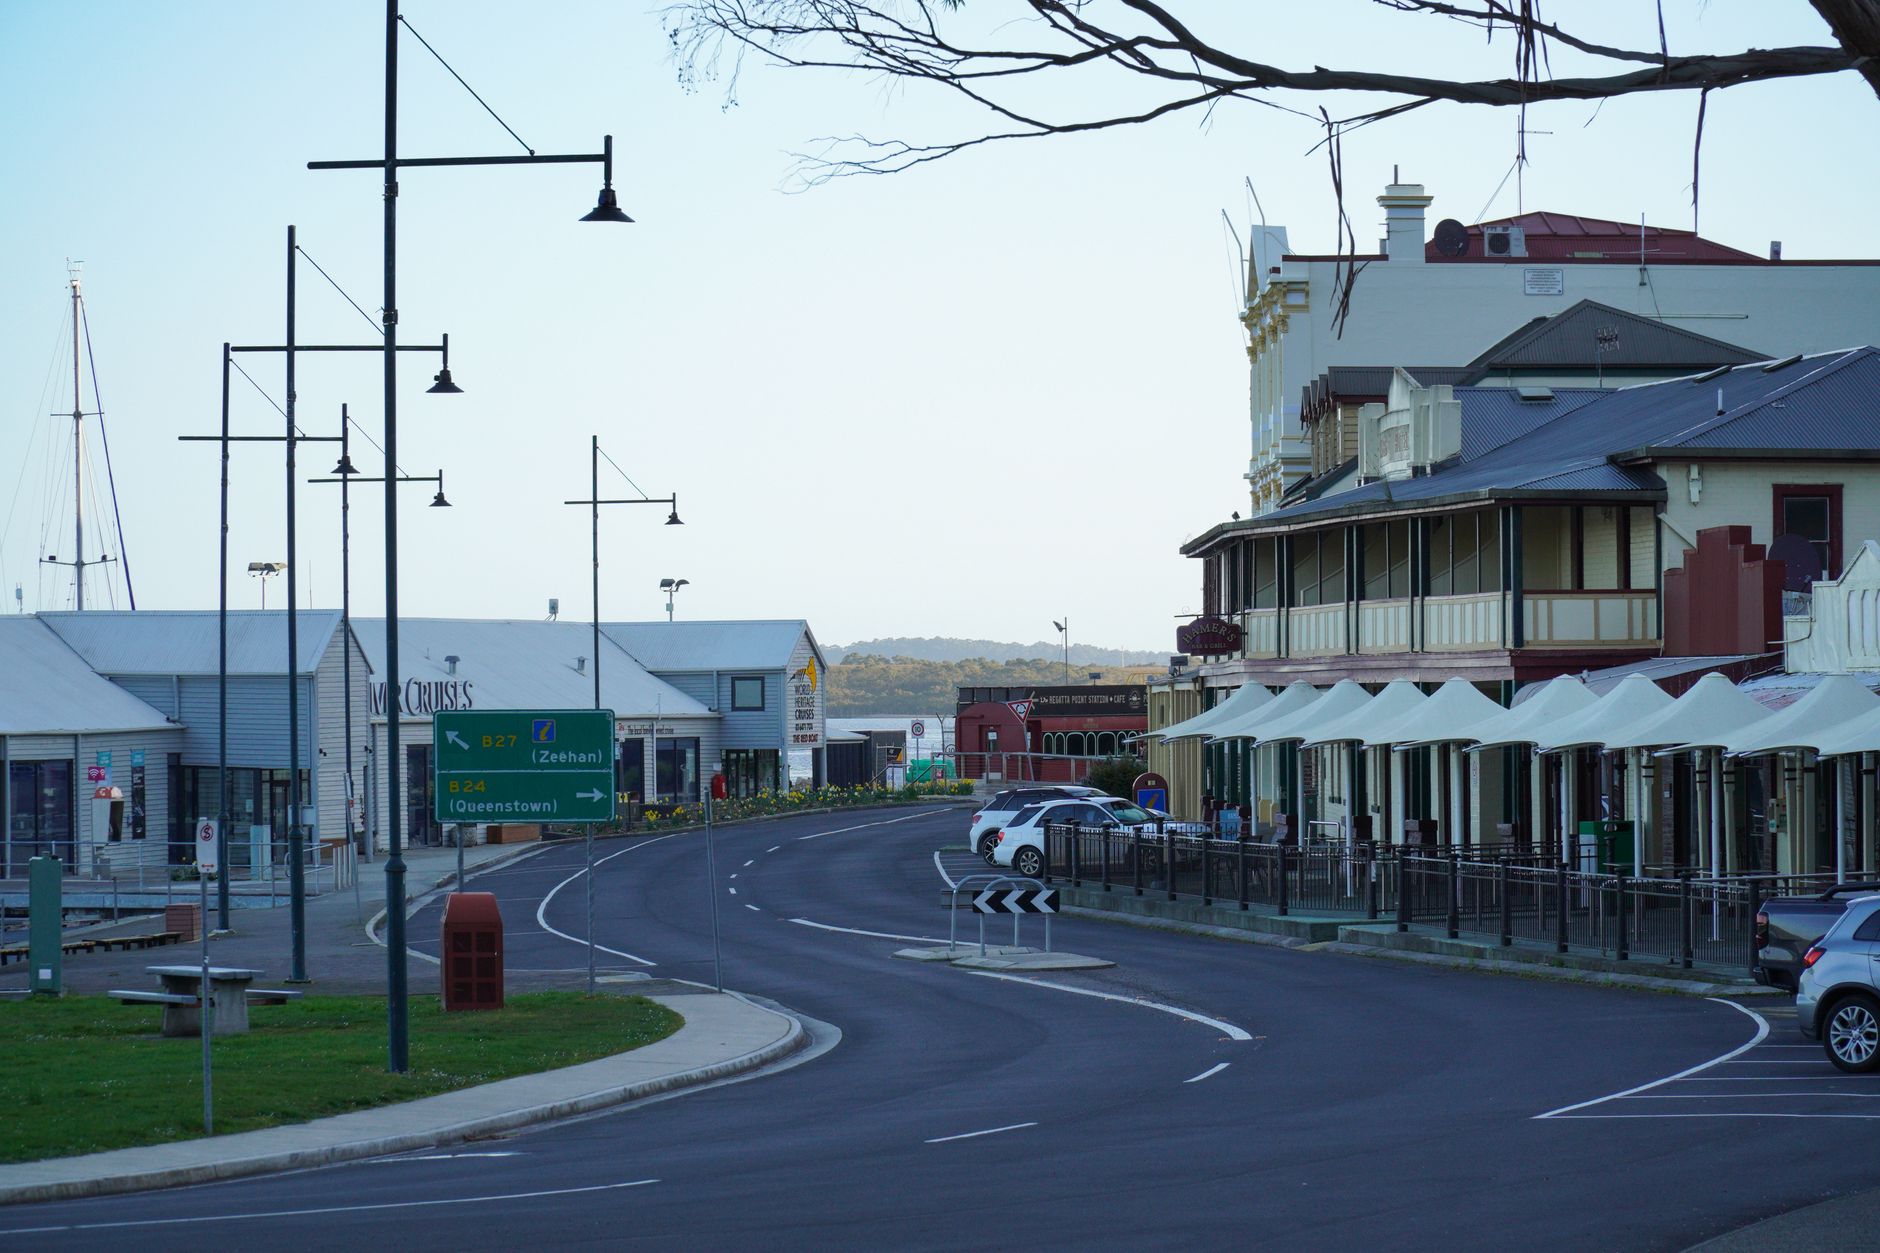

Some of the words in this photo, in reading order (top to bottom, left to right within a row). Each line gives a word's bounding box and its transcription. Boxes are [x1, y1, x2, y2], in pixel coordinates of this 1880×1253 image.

[1182, 623, 1236, 643] HAMER'S
[794, 684, 812, 695] WORLD
[405, 677, 473, 716] CRUISES
[794, 696, 815, 708] HERITAGE
[1049, 695, 1070, 704] REGATTA
[1071, 695, 1087, 704] POINT
[1088, 695, 1109, 704] STATION
[1114, 695, 1126, 704] CAFE
[794, 708, 815, 720] CRUISES
[914, 725, 922, 733] 10
[482, 735, 517, 748] B27
[808, 733, 818, 743] BOAT
[532, 749, 603, 765] (Zeehan)
[449, 780, 486, 793] B24
[449, 799, 558, 814] (Queenstown)
